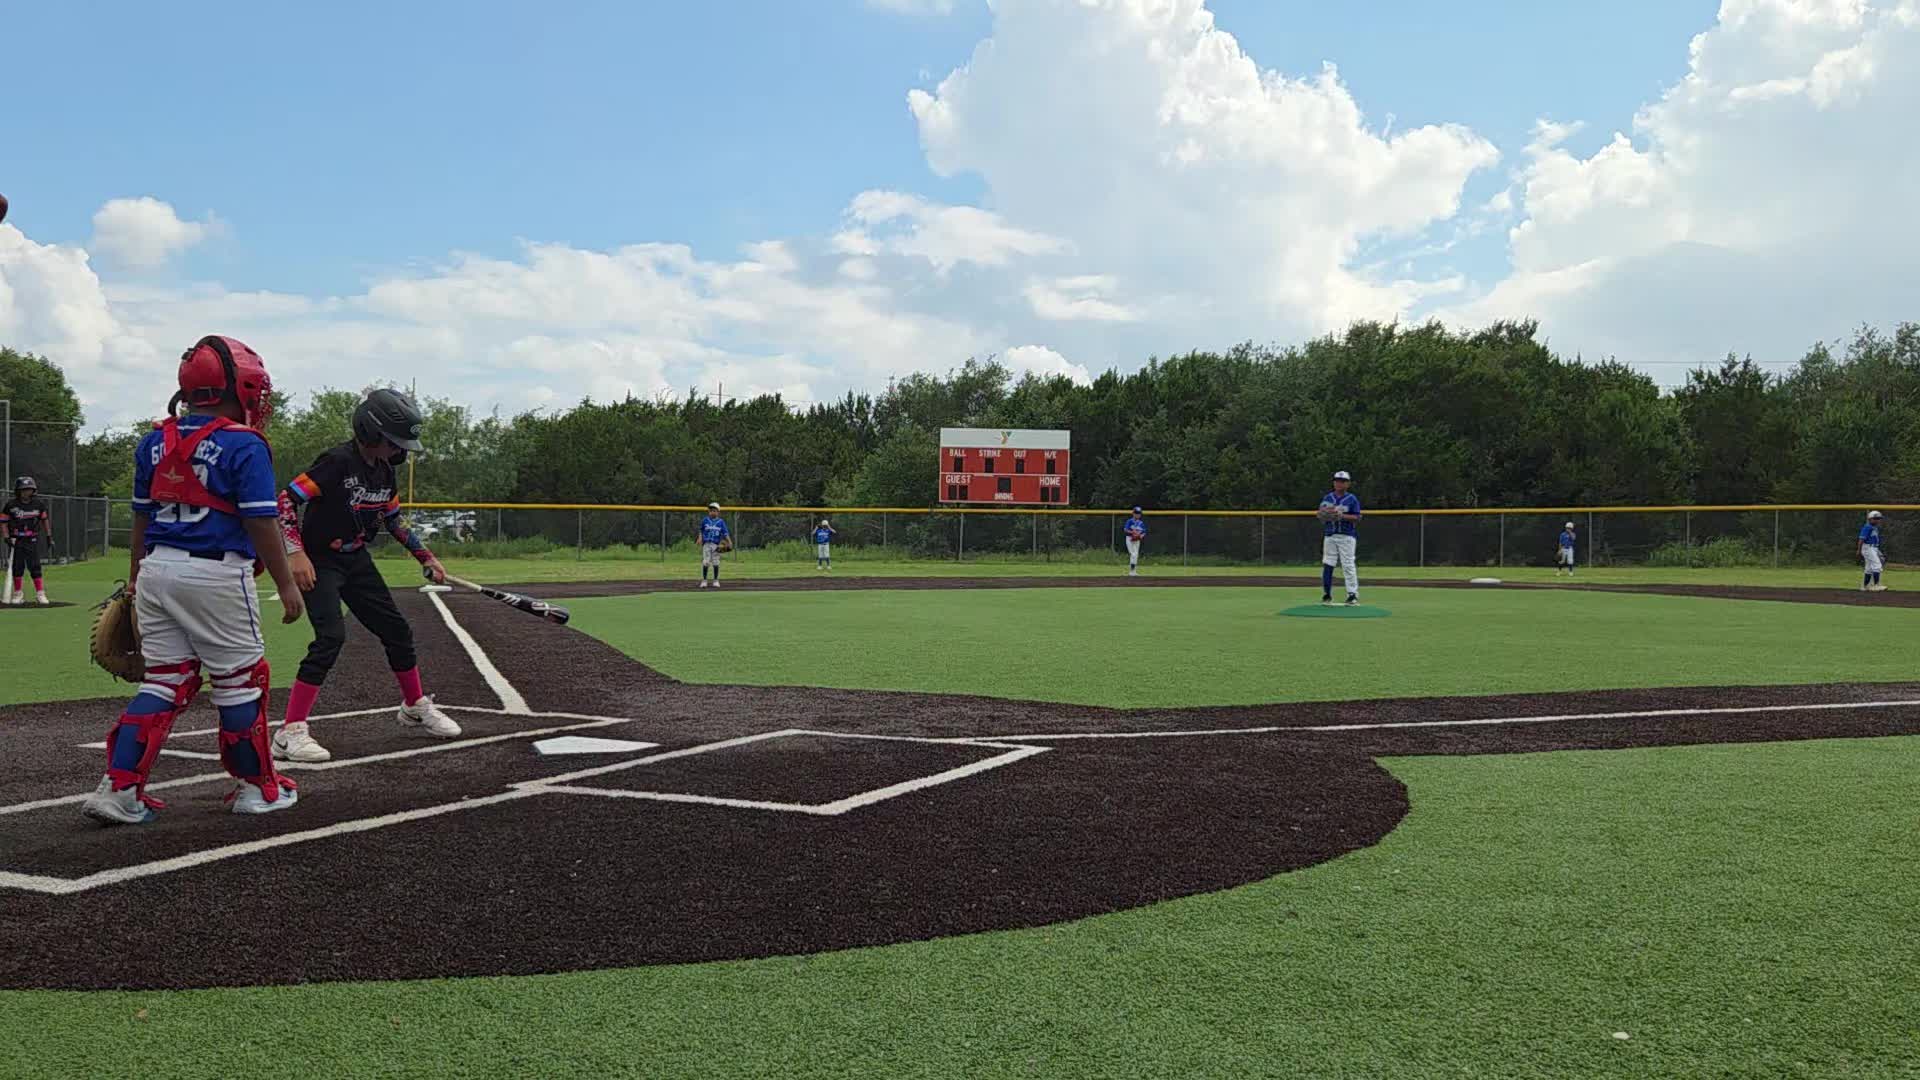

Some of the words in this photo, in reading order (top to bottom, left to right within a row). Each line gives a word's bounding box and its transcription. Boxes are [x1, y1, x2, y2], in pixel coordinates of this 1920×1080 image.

[949, 449, 967, 457] BALL
[979, 449, 1002, 457] STRIKE
[945, 474, 972, 484] GUEST
[1039, 477, 1061, 486] HOME
